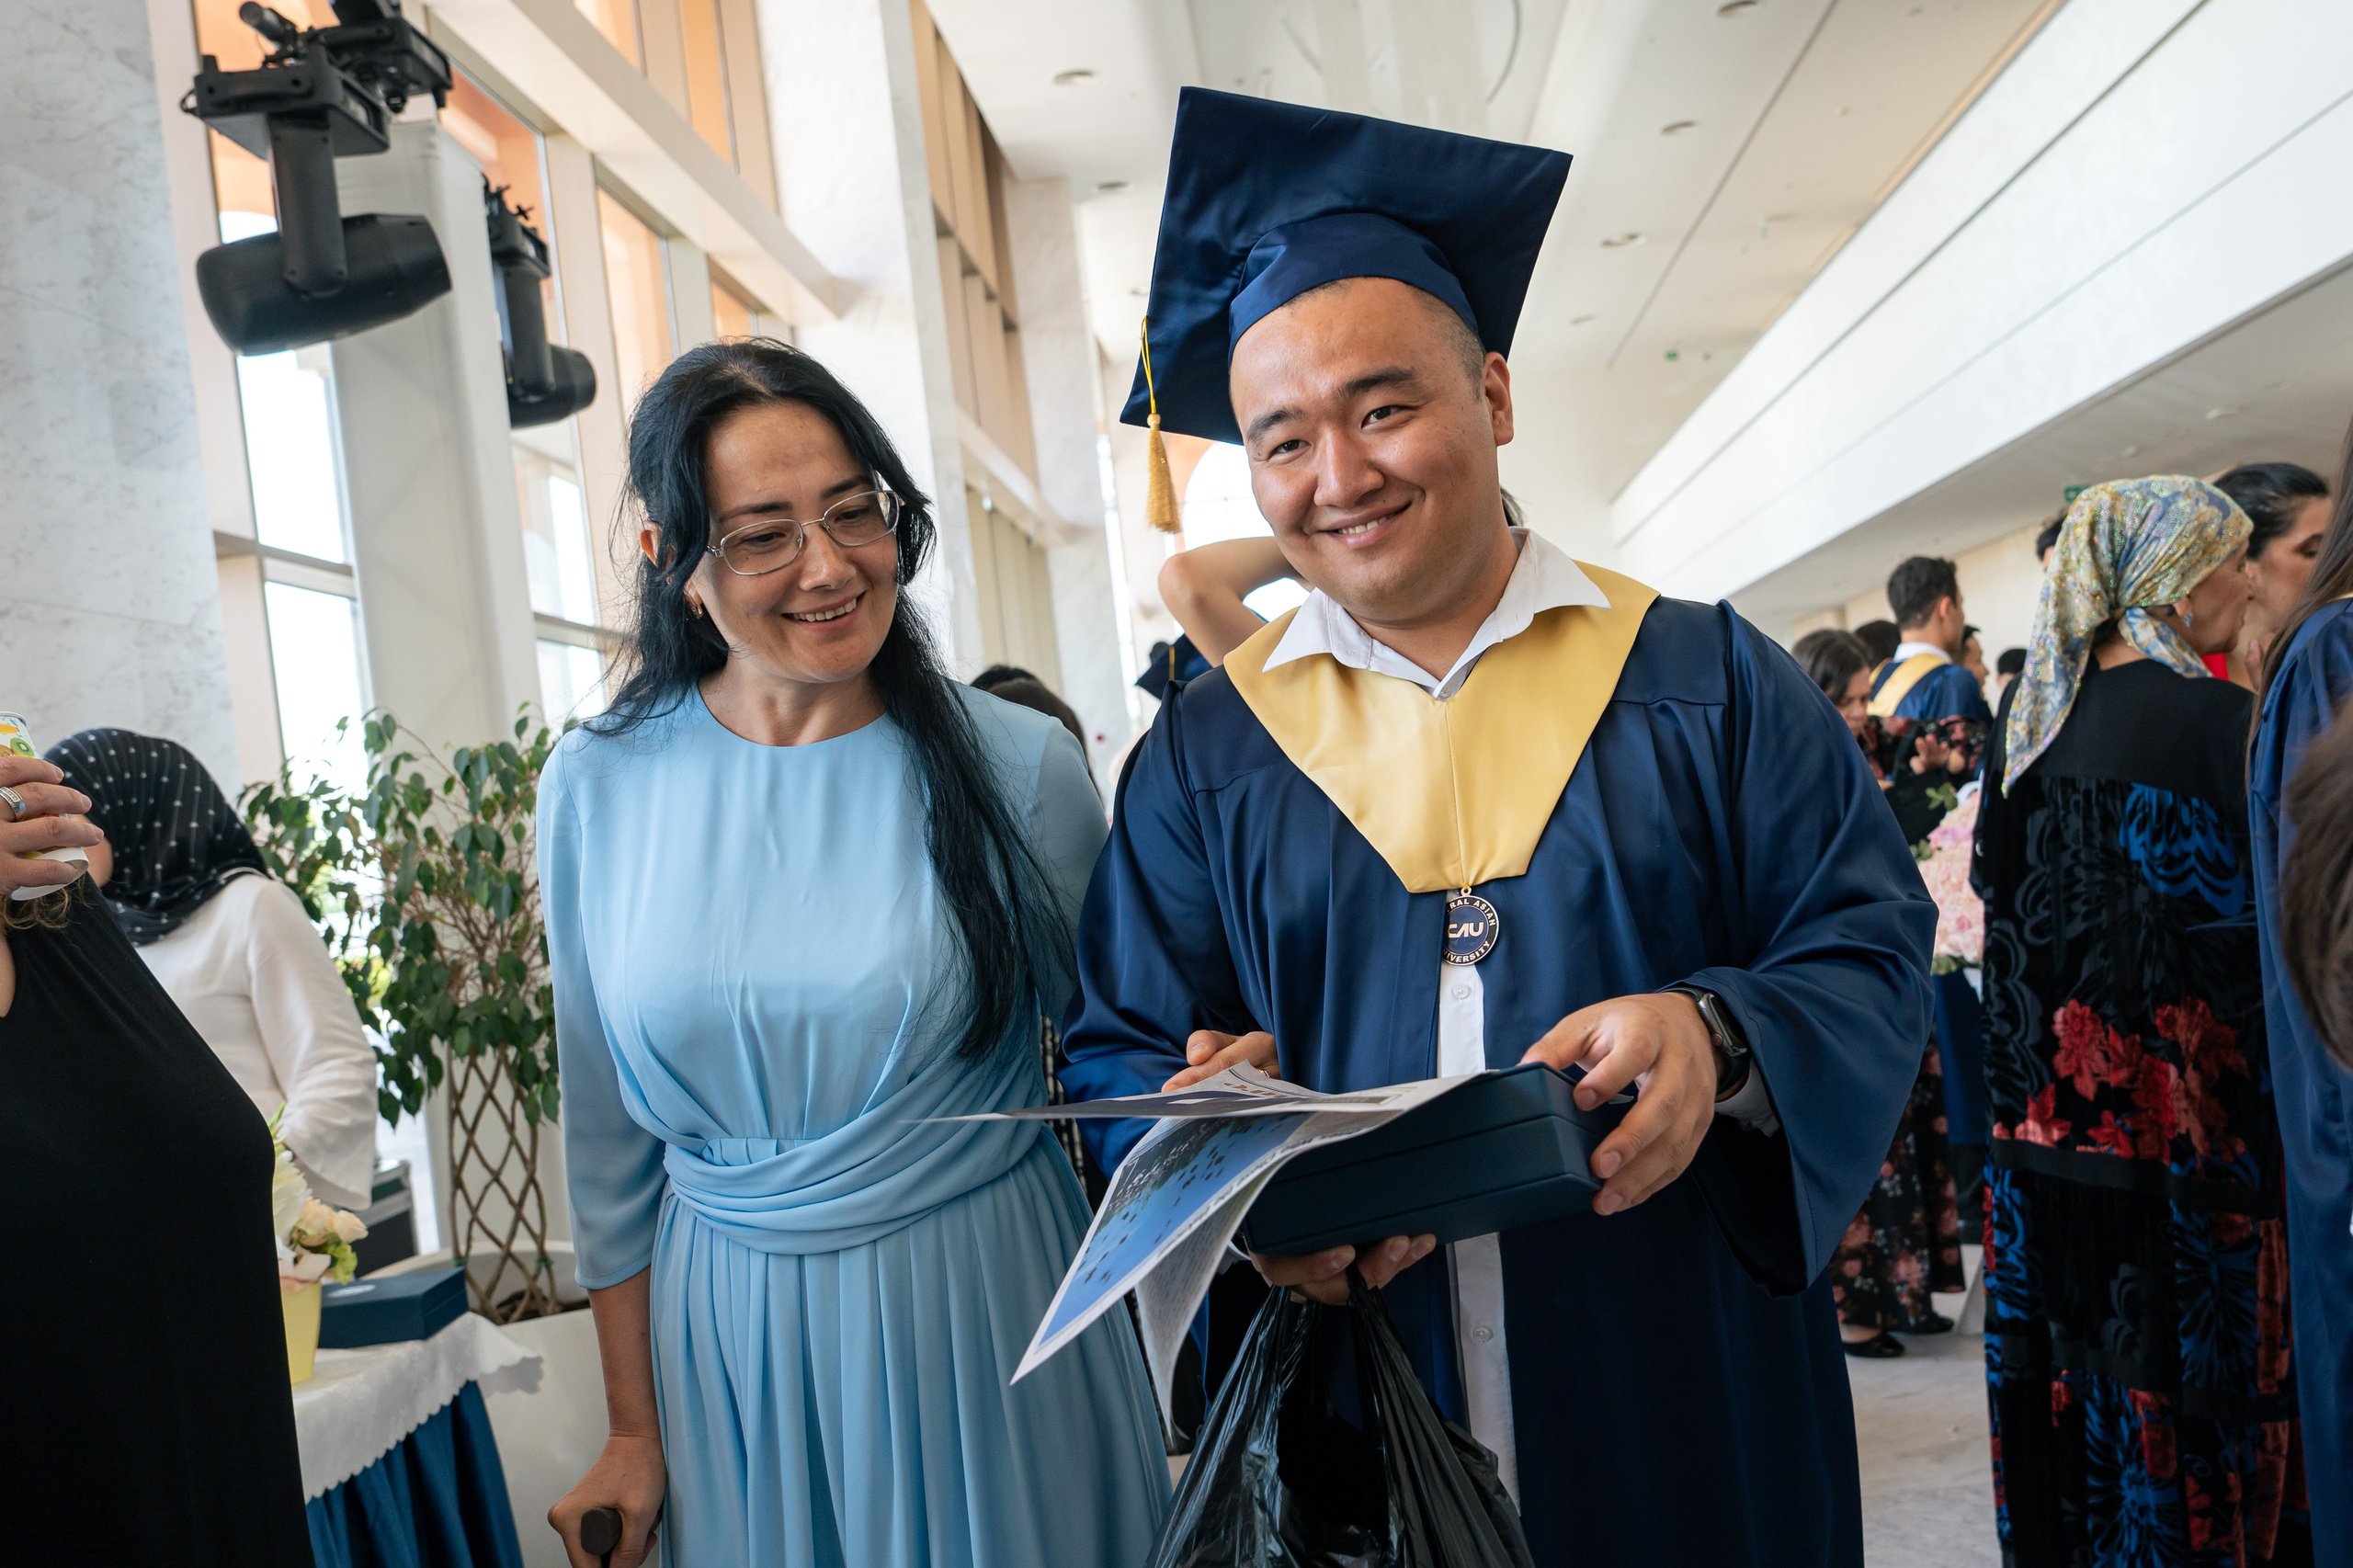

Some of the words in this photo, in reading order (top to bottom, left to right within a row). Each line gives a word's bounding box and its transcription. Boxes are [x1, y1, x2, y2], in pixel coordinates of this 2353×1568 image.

[1447, 898, 1470, 912] RAL
[1473, 900, 1496, 926] ASIAN
[1448, 922, 1484, 938] CAU
